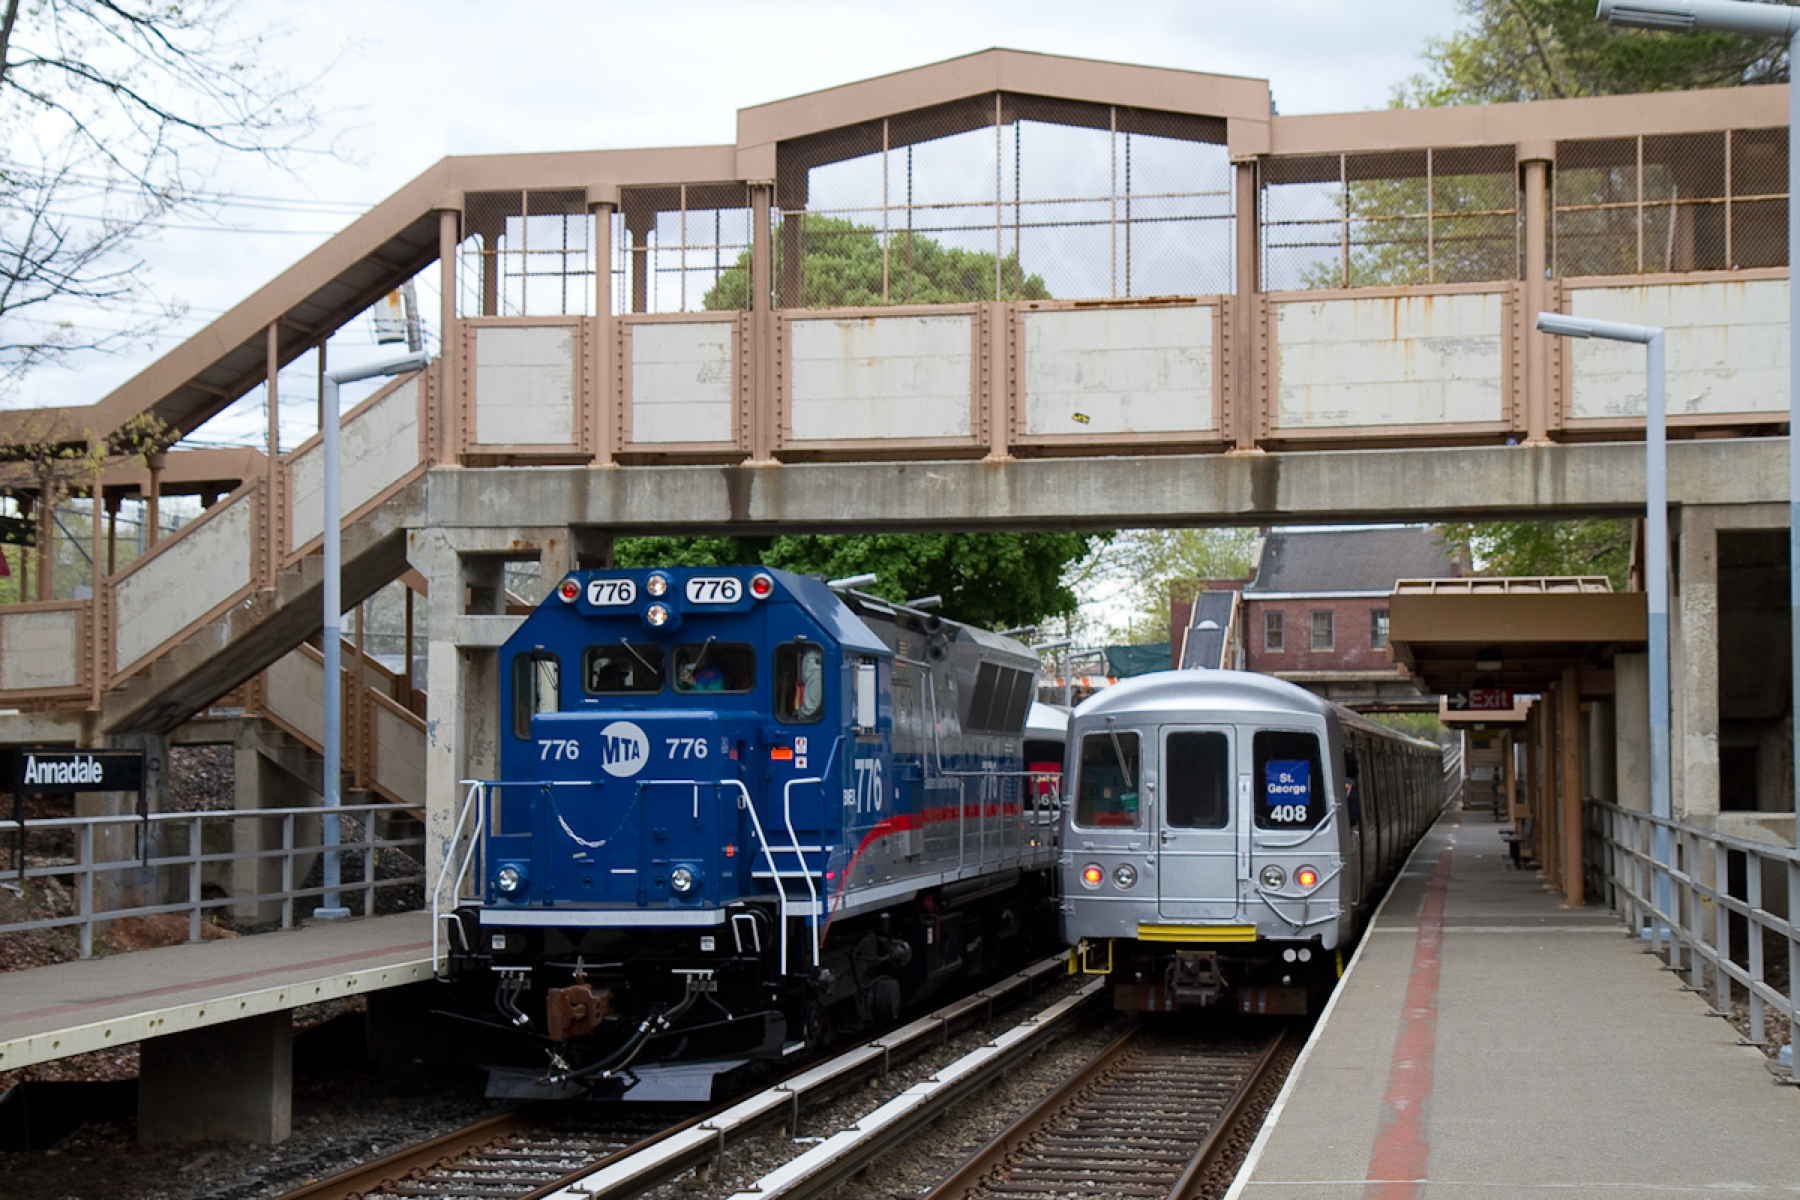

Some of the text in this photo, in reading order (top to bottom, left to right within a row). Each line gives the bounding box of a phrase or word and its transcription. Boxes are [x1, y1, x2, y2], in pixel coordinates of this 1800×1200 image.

[592, 582, 631, 602] 776
[691, 580, 736, 600] 776
[1468, 689, 1508, 708] Exit
[538, 739, 580, 760] 776
[601, 733, 641, 765] MTA
[665, 738, 709, 760] 776
[24, 755, 103, 784] Annadale
[1279, 773, 1295, 783] St.
[854, 758, 883, 813] 776
[1267, 783, 1306, 795] George
[1271, 805, 1307, 822] 408
